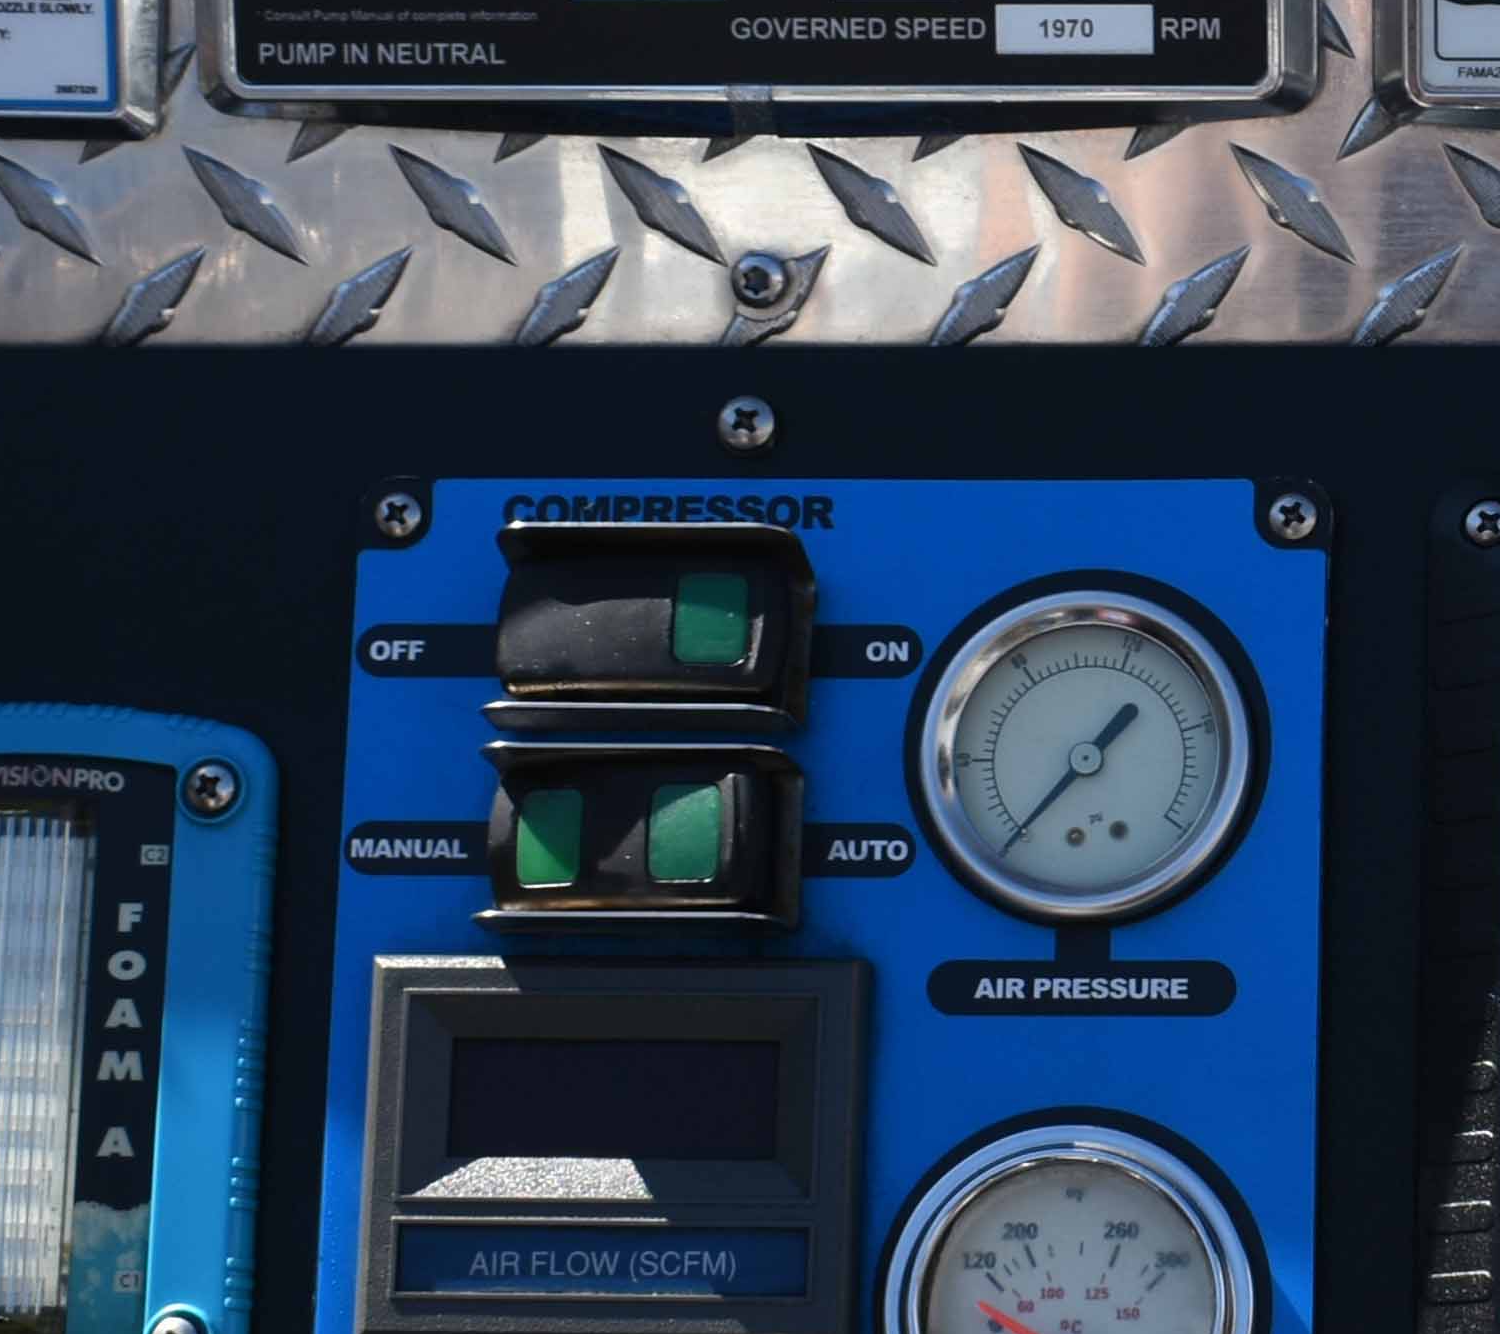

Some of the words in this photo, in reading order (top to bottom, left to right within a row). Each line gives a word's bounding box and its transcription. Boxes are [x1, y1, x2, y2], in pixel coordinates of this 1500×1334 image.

[731, 17, 886, 39] GOVERNED
[895, 17, 986, 39] SPEED
[1039, 19, 1093, 38] 1970
[1160, 17, 1222, 40] RPM
[259, 43, 336, 64] PUMP
[343, 43, 368, 64] IN
[377, 43, 505, 64] NEUTRAL
[503, 495, 834, 530] COMPRESSOR
[370, 640, 425, 661] OFF
[866, 641, 908, 662] ON
[351, 838, 468, 858] MANUAL
[828, 840, 908, 861] AUTO
[97, 903, 146, 1080] FOAM
[974, 978, 1025, 999] AIR
[1033, 978, 1188, 999] PRESSURE
[97, 1127, 136, 1159] A
[1002, 1222, 1038, 1240] 200
[1104, 1221, 1139, 1239] 260
[469, 1251, 520, 1275] AIR
[531, 1251, 620, 1276] FLOW
[630, 1251, 736, 1283] (SCFM)
